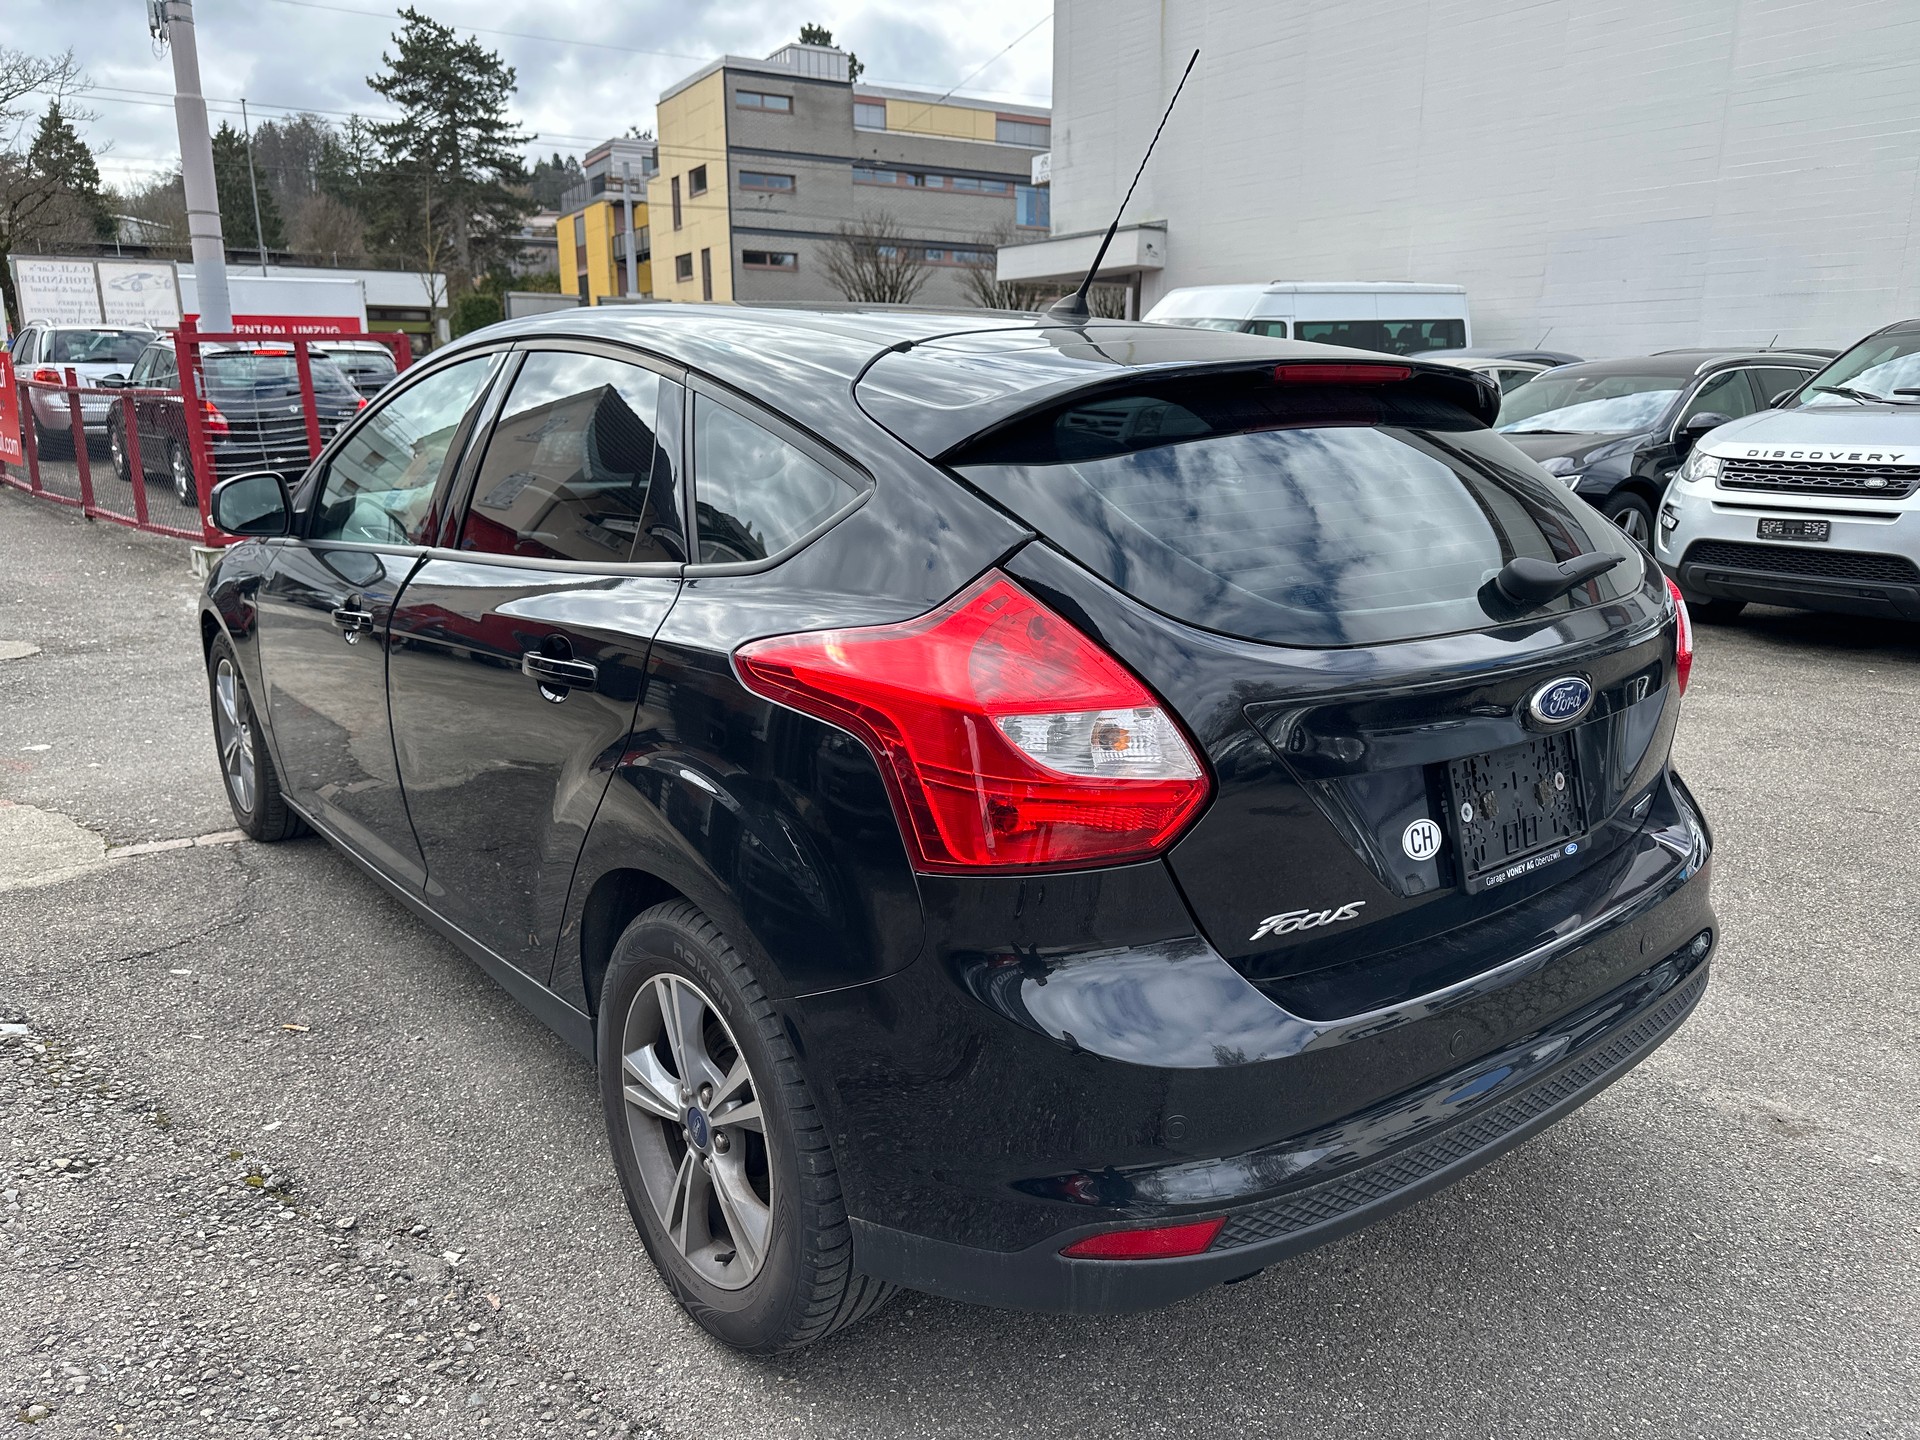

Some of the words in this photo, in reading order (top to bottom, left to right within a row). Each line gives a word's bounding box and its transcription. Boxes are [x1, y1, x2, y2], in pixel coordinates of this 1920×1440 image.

[1746, 449, 1905, 462] DISCOVERY
[1550, 685, 1582, 714] Ford
[1410, 825, 1434, 854] CH
[1485, 872, 1506, 886] Garage
[1505, 863, 1526, 878] VONEY
[1526, 860, 1535, 870] AG
